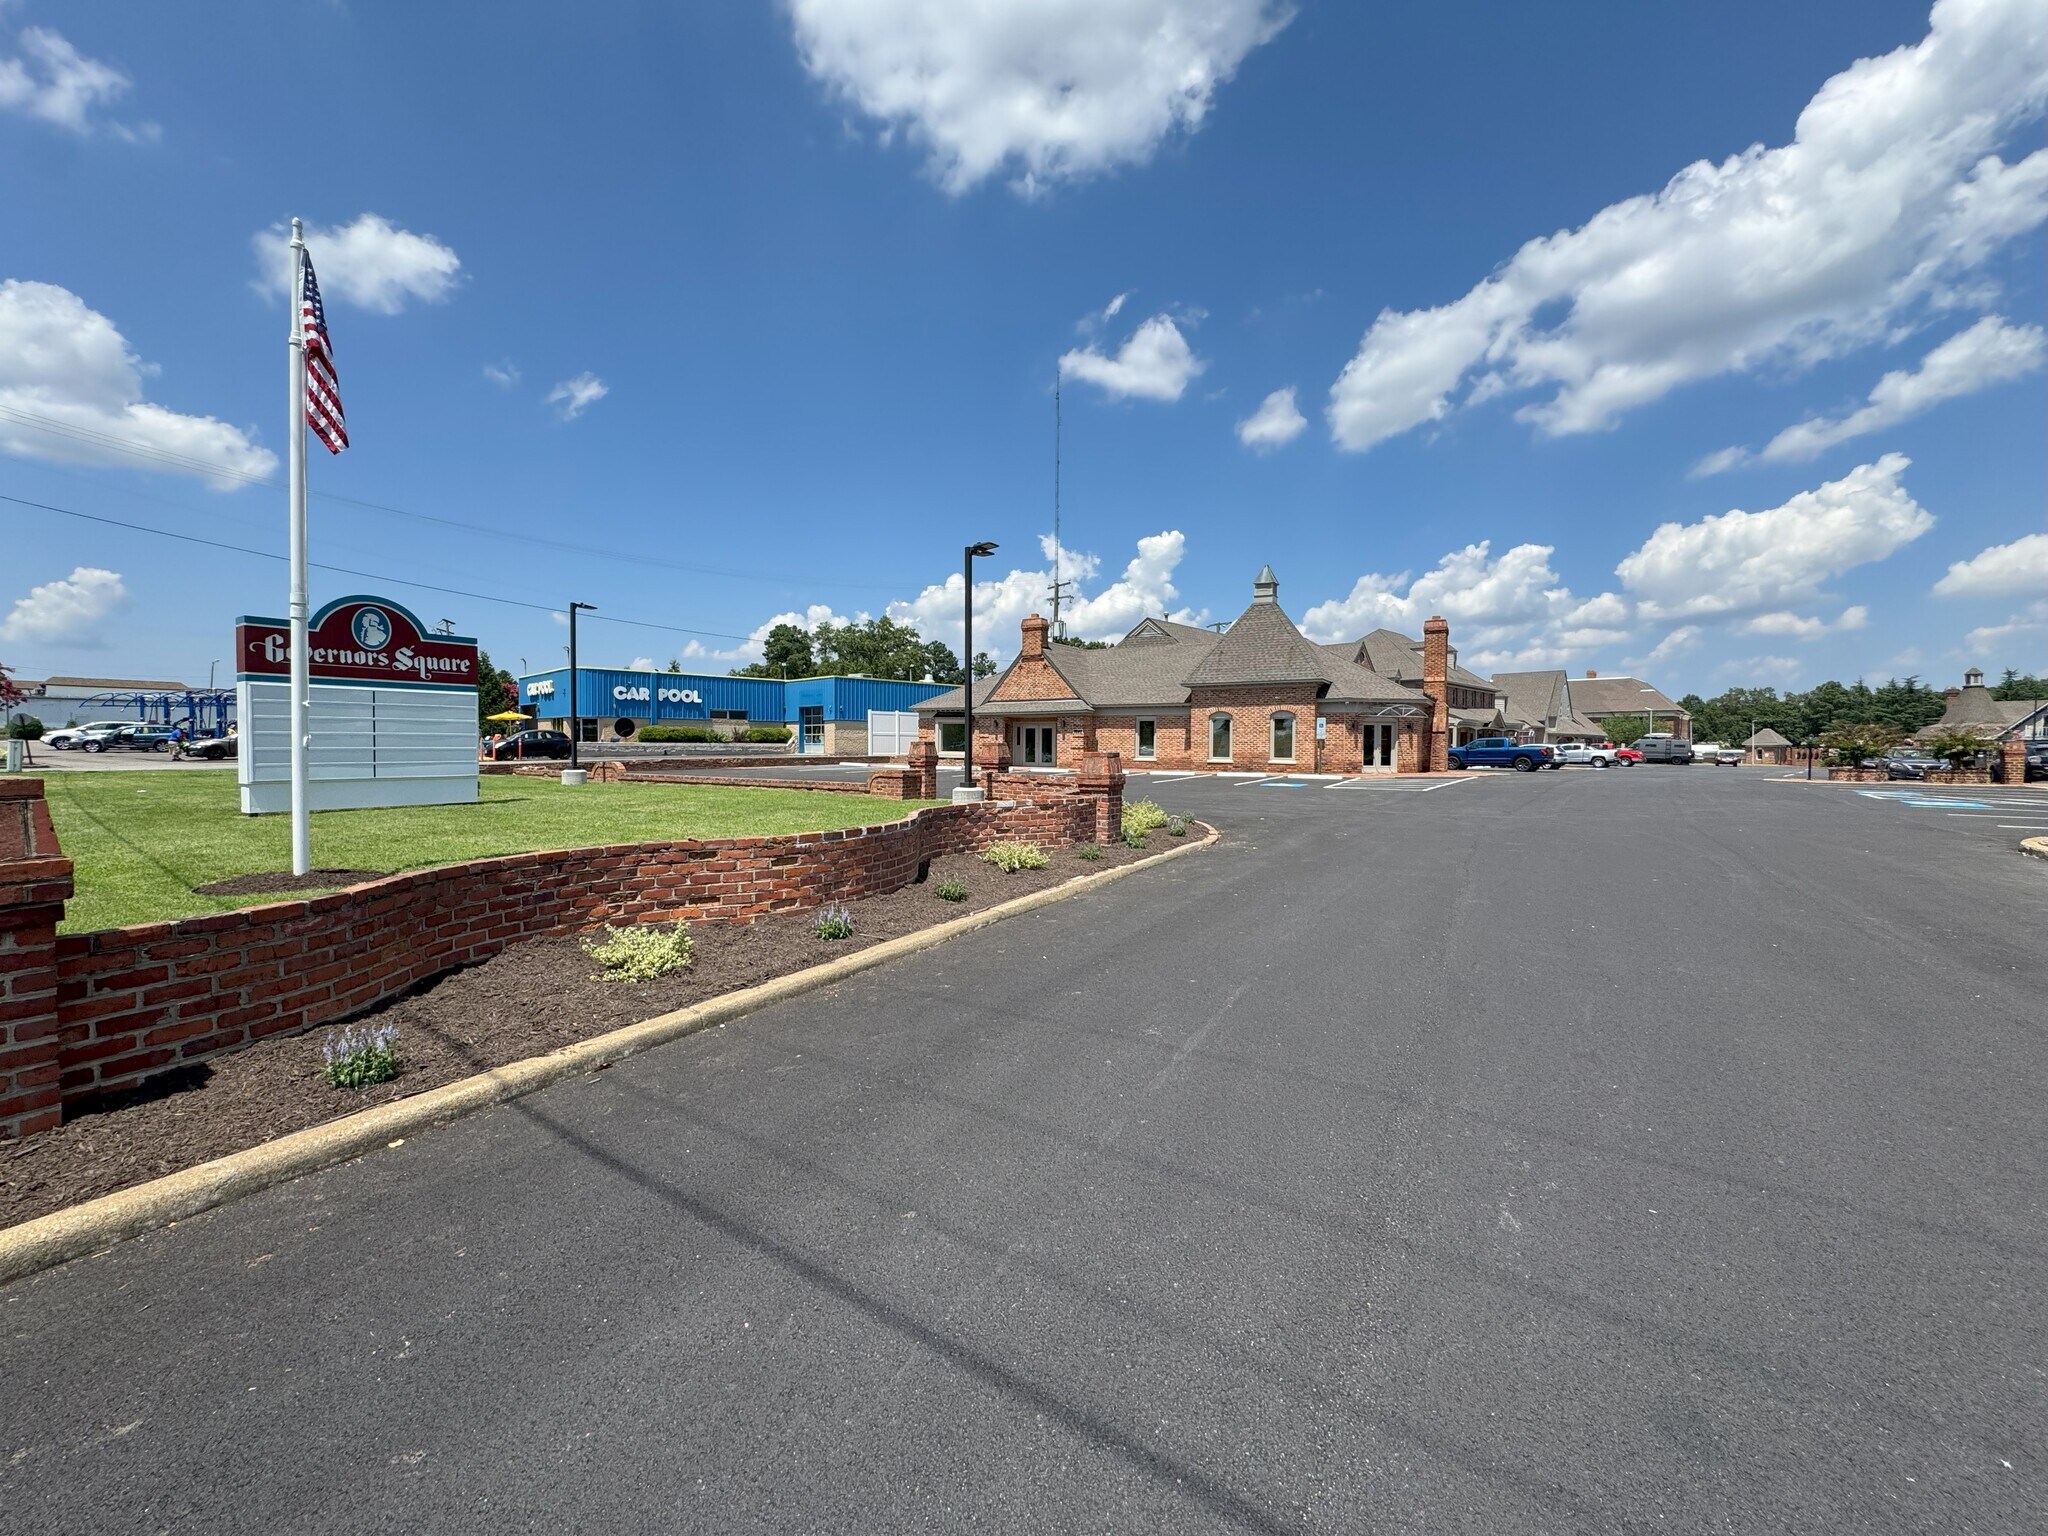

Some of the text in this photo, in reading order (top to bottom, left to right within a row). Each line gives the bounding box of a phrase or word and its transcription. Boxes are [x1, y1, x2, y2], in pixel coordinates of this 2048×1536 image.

[249, 634, 470, 680] Gernors Square
[613, 686, 702, 703] CAR POOL
